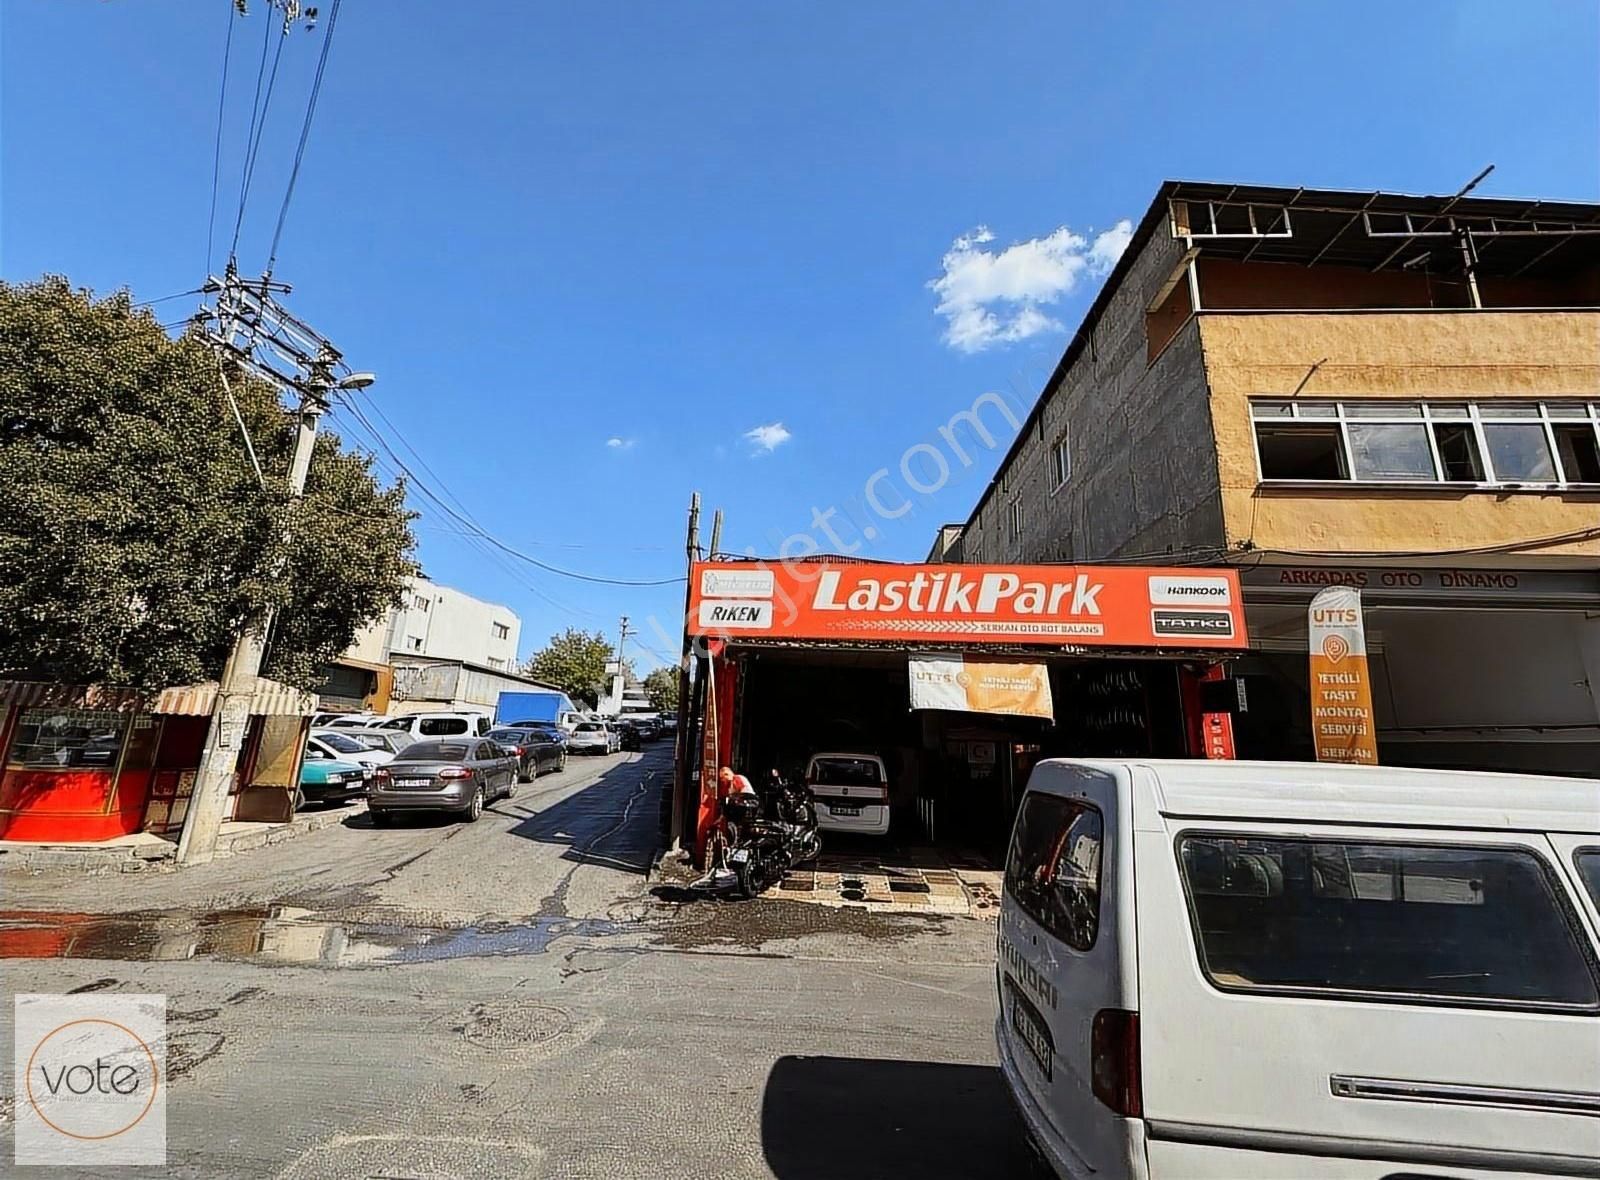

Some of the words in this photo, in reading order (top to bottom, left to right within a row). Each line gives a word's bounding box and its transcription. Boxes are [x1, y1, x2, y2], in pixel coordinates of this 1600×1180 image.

[1382, 572, 1422, 586] OTO
[1313, 608, 1358, 623] UTTS
[980, 623, 1017, 632] SERKAN
[1020, 624, 1039, 633] OTO
[1061, 625, 1099, 634] BALANS
[1155, 618, 1229, 628] TATKO
[1321, 690, 1357, 702] TAŞIT
[1315, 707, 1368, 718] MONTAJ
[1321, 747, 1372, 759] SERKAN
